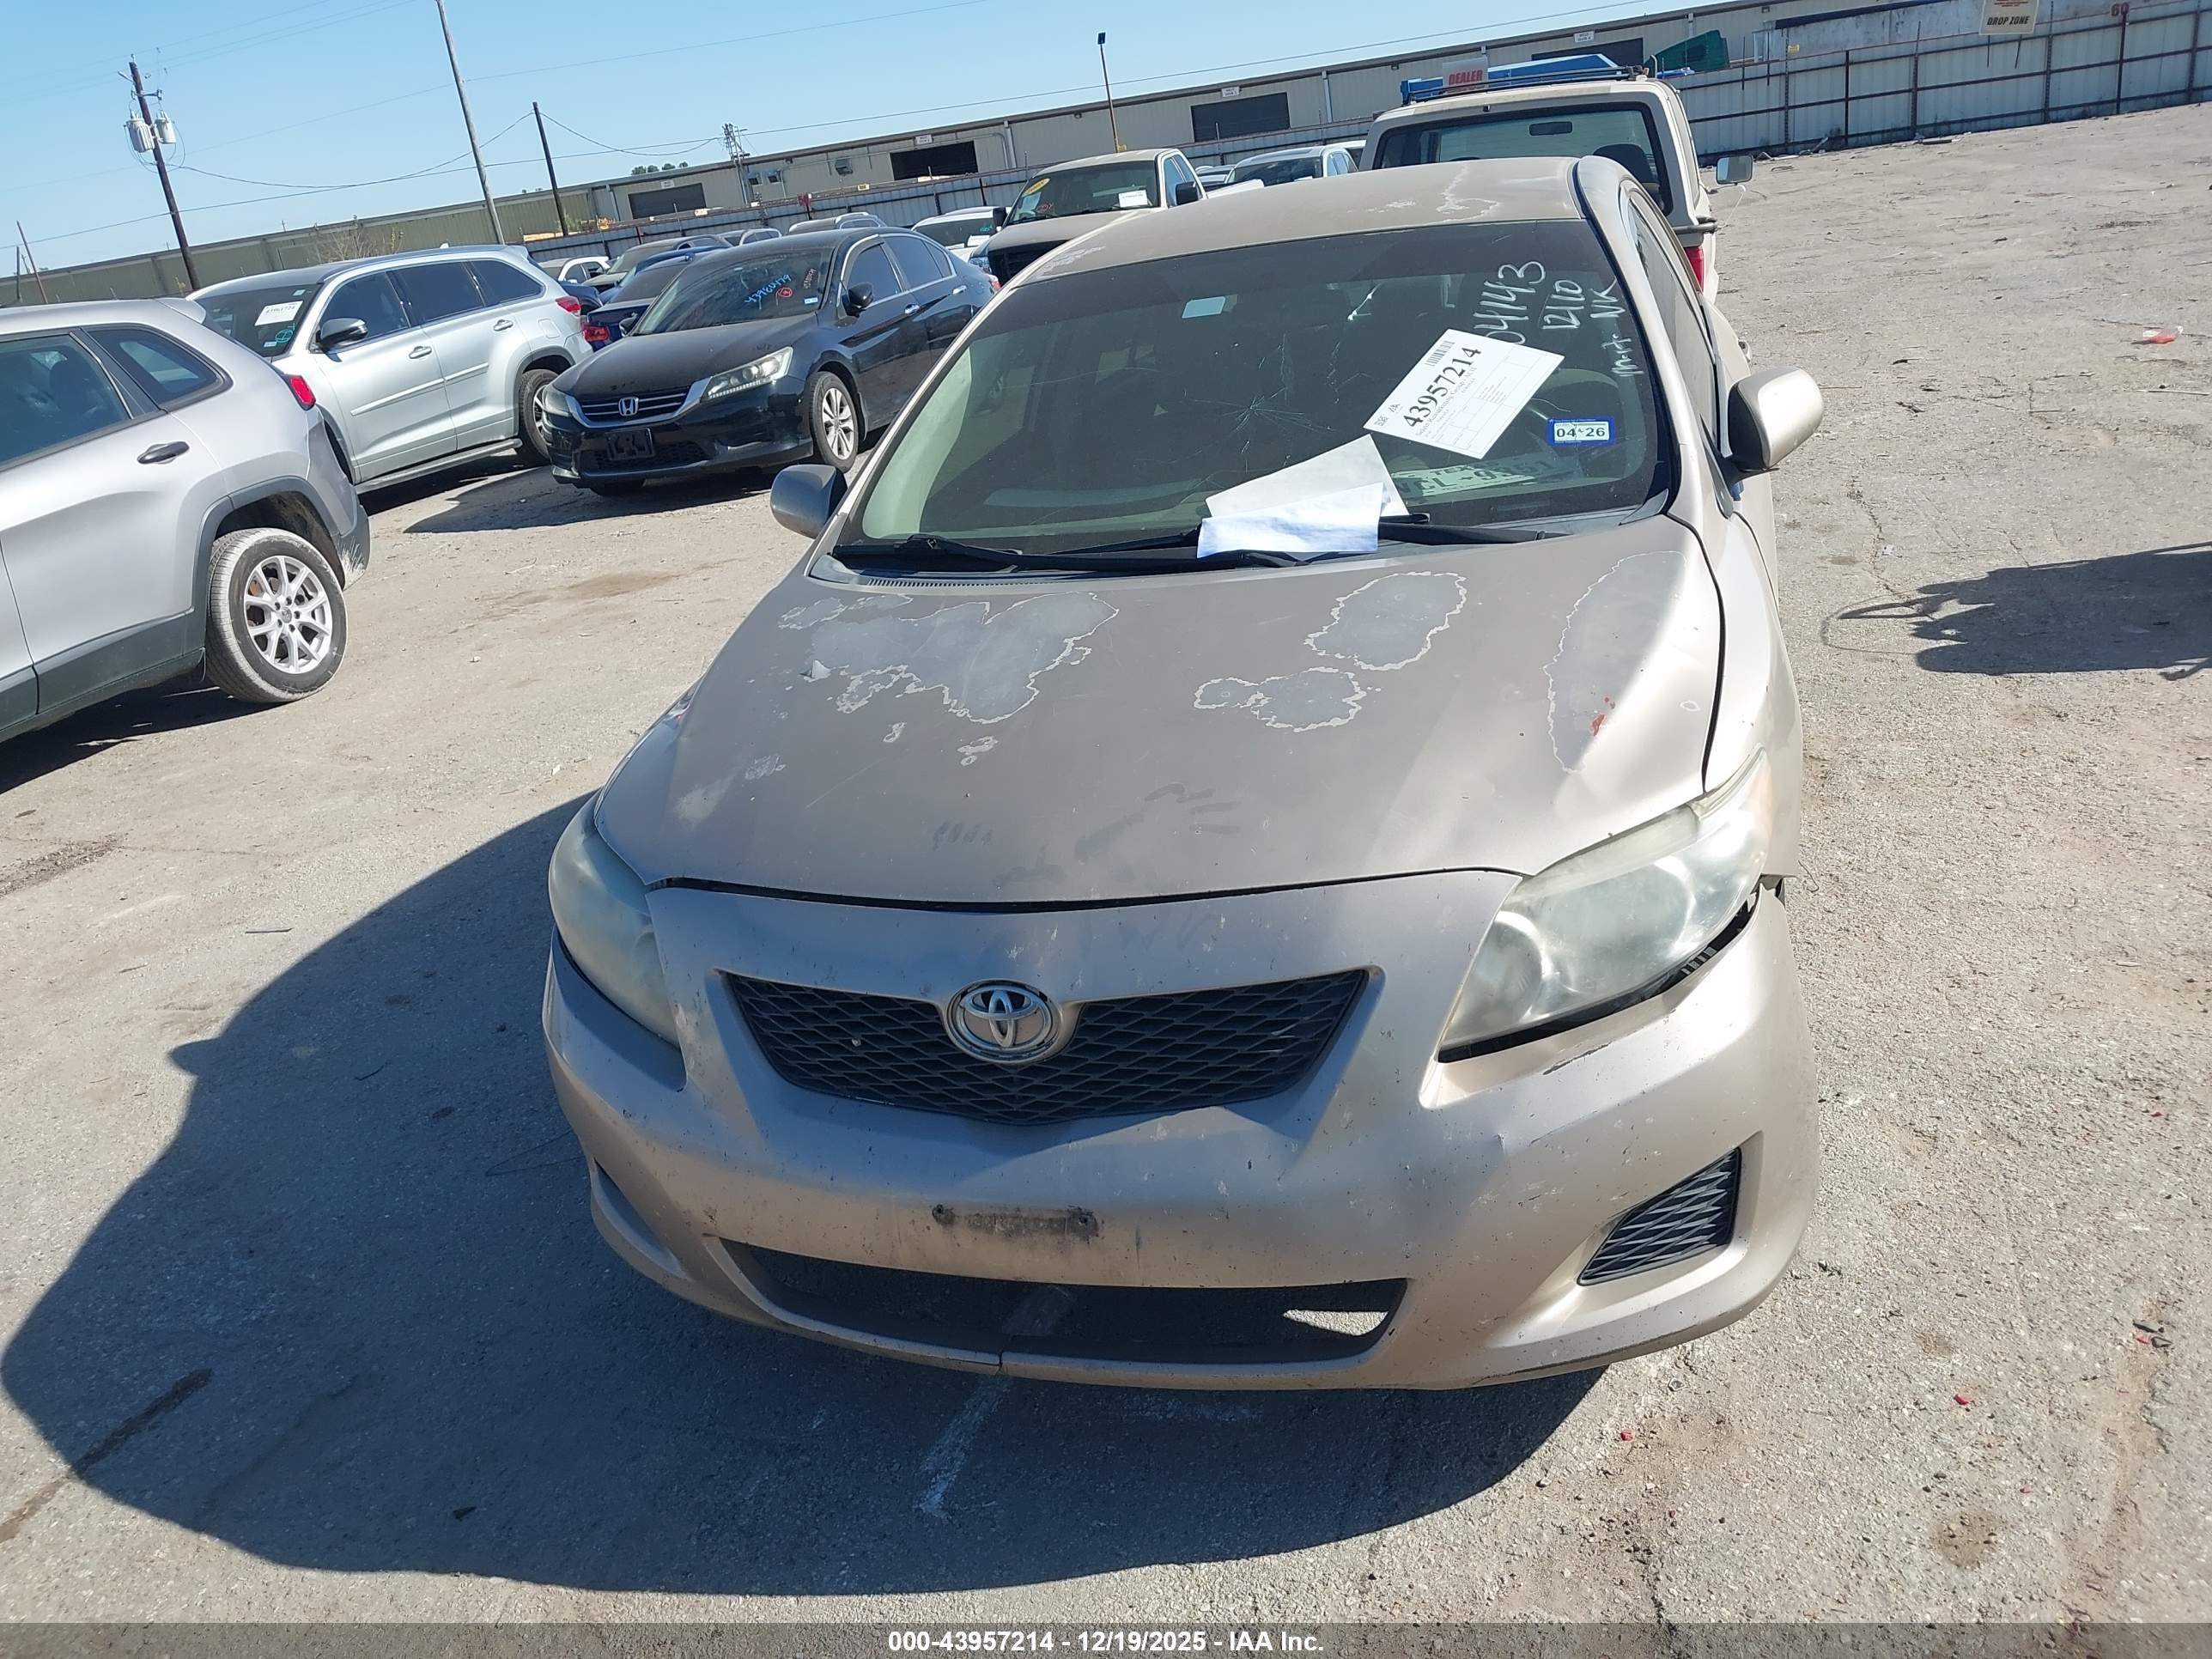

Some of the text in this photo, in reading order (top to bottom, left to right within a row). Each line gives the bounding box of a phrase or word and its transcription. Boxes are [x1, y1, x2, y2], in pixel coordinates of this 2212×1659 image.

[1987, 15, 2030, 26] DROP ZONE
[1449, 70, 1484, 86] DEALER
[1403, 347, 1482, 428] 43957214
[1556, 427, 1606, 438] 04 26
